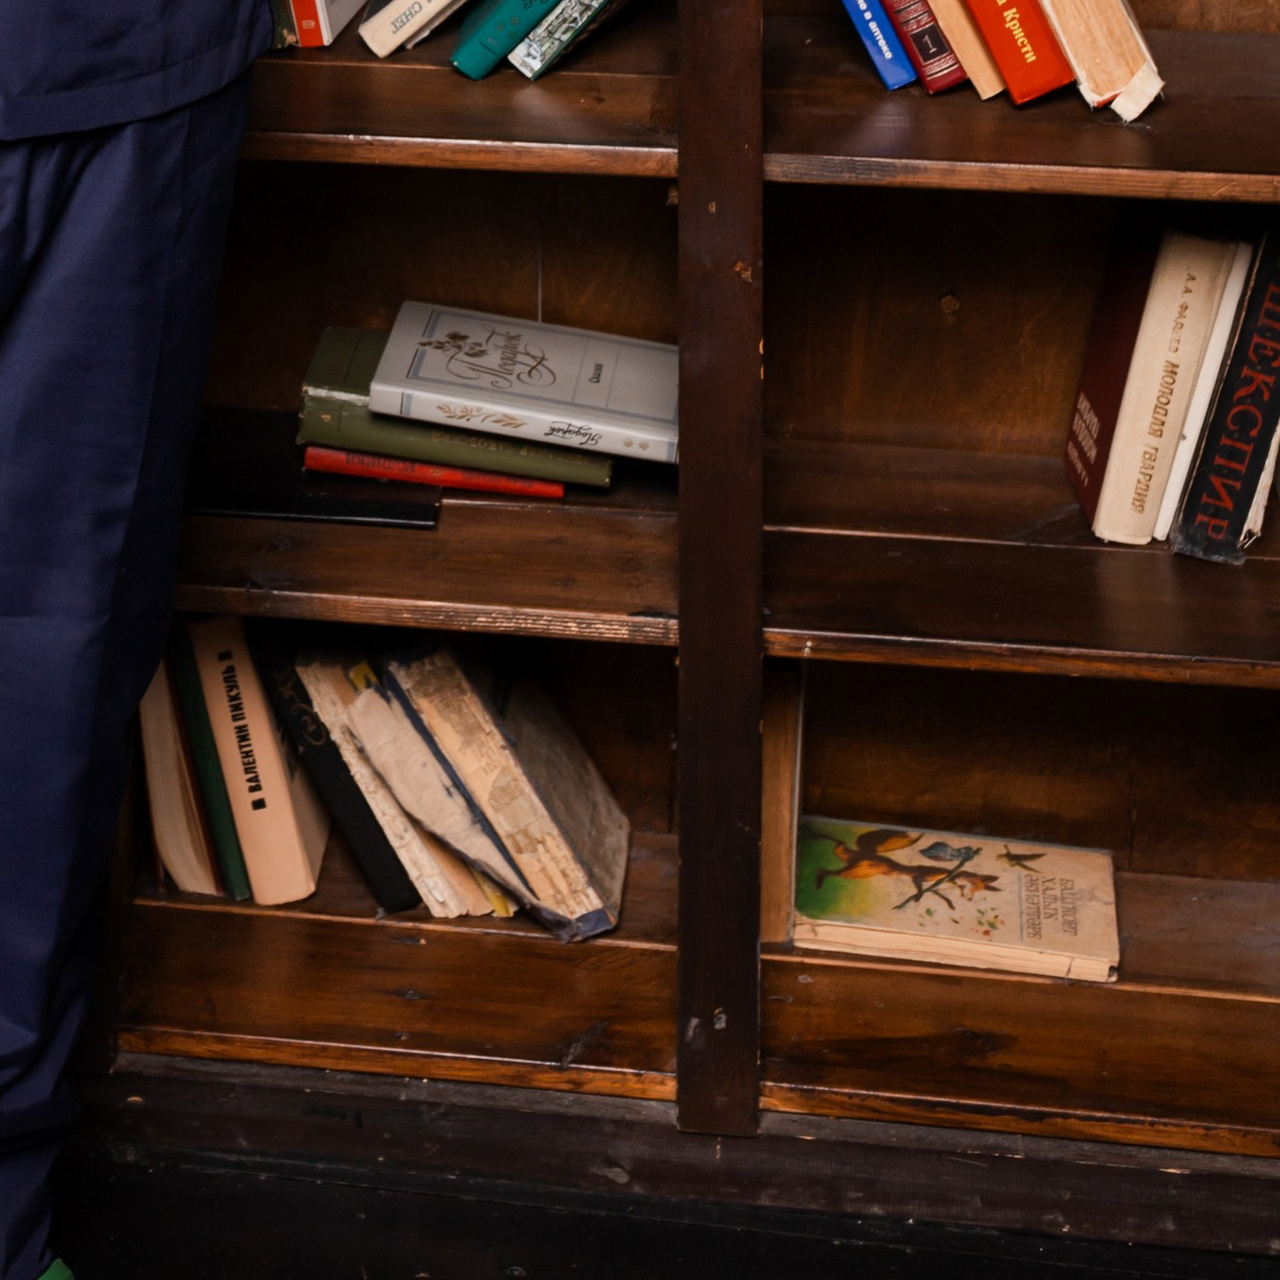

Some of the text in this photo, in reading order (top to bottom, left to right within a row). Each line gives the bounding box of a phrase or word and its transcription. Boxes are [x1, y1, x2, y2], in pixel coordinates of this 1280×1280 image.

[390, 0, 425, 36] СНЕГ
[1002, 5, 1036, 65] Кристи
[544, 421, 603, 448] Подарок
[1130, 359, 1180, 516] МОЛОДАЯ ГВАРДИЯ
[1194, 281, 1280, 541] ШЕКСПИР
[223, 663, 263, 795] ВАЛЕНТИН ПИКУЛЬ
